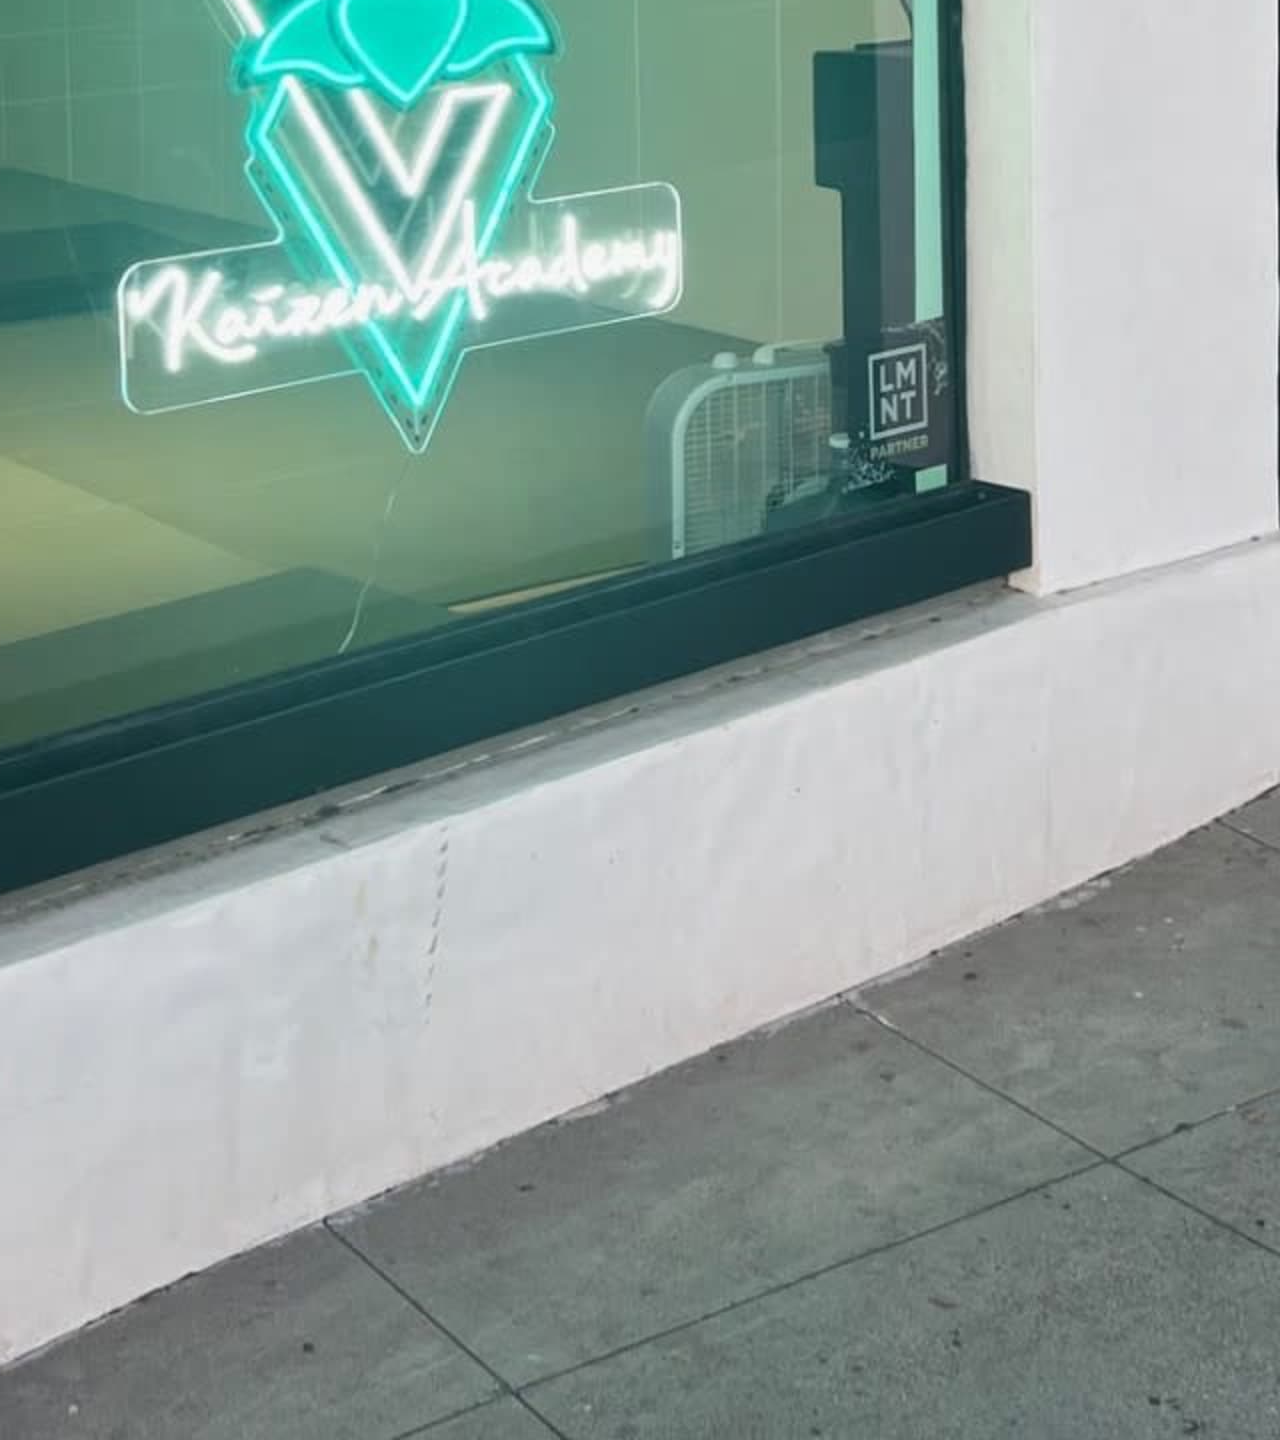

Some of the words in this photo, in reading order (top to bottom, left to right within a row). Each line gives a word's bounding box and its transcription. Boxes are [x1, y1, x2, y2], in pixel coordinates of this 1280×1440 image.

[127, 265, 403, 372] Kaizen
[410, 199, 678, 321] Academy
[880, 357, 917, 394] LM
[881, 390, 917, 425] NT
